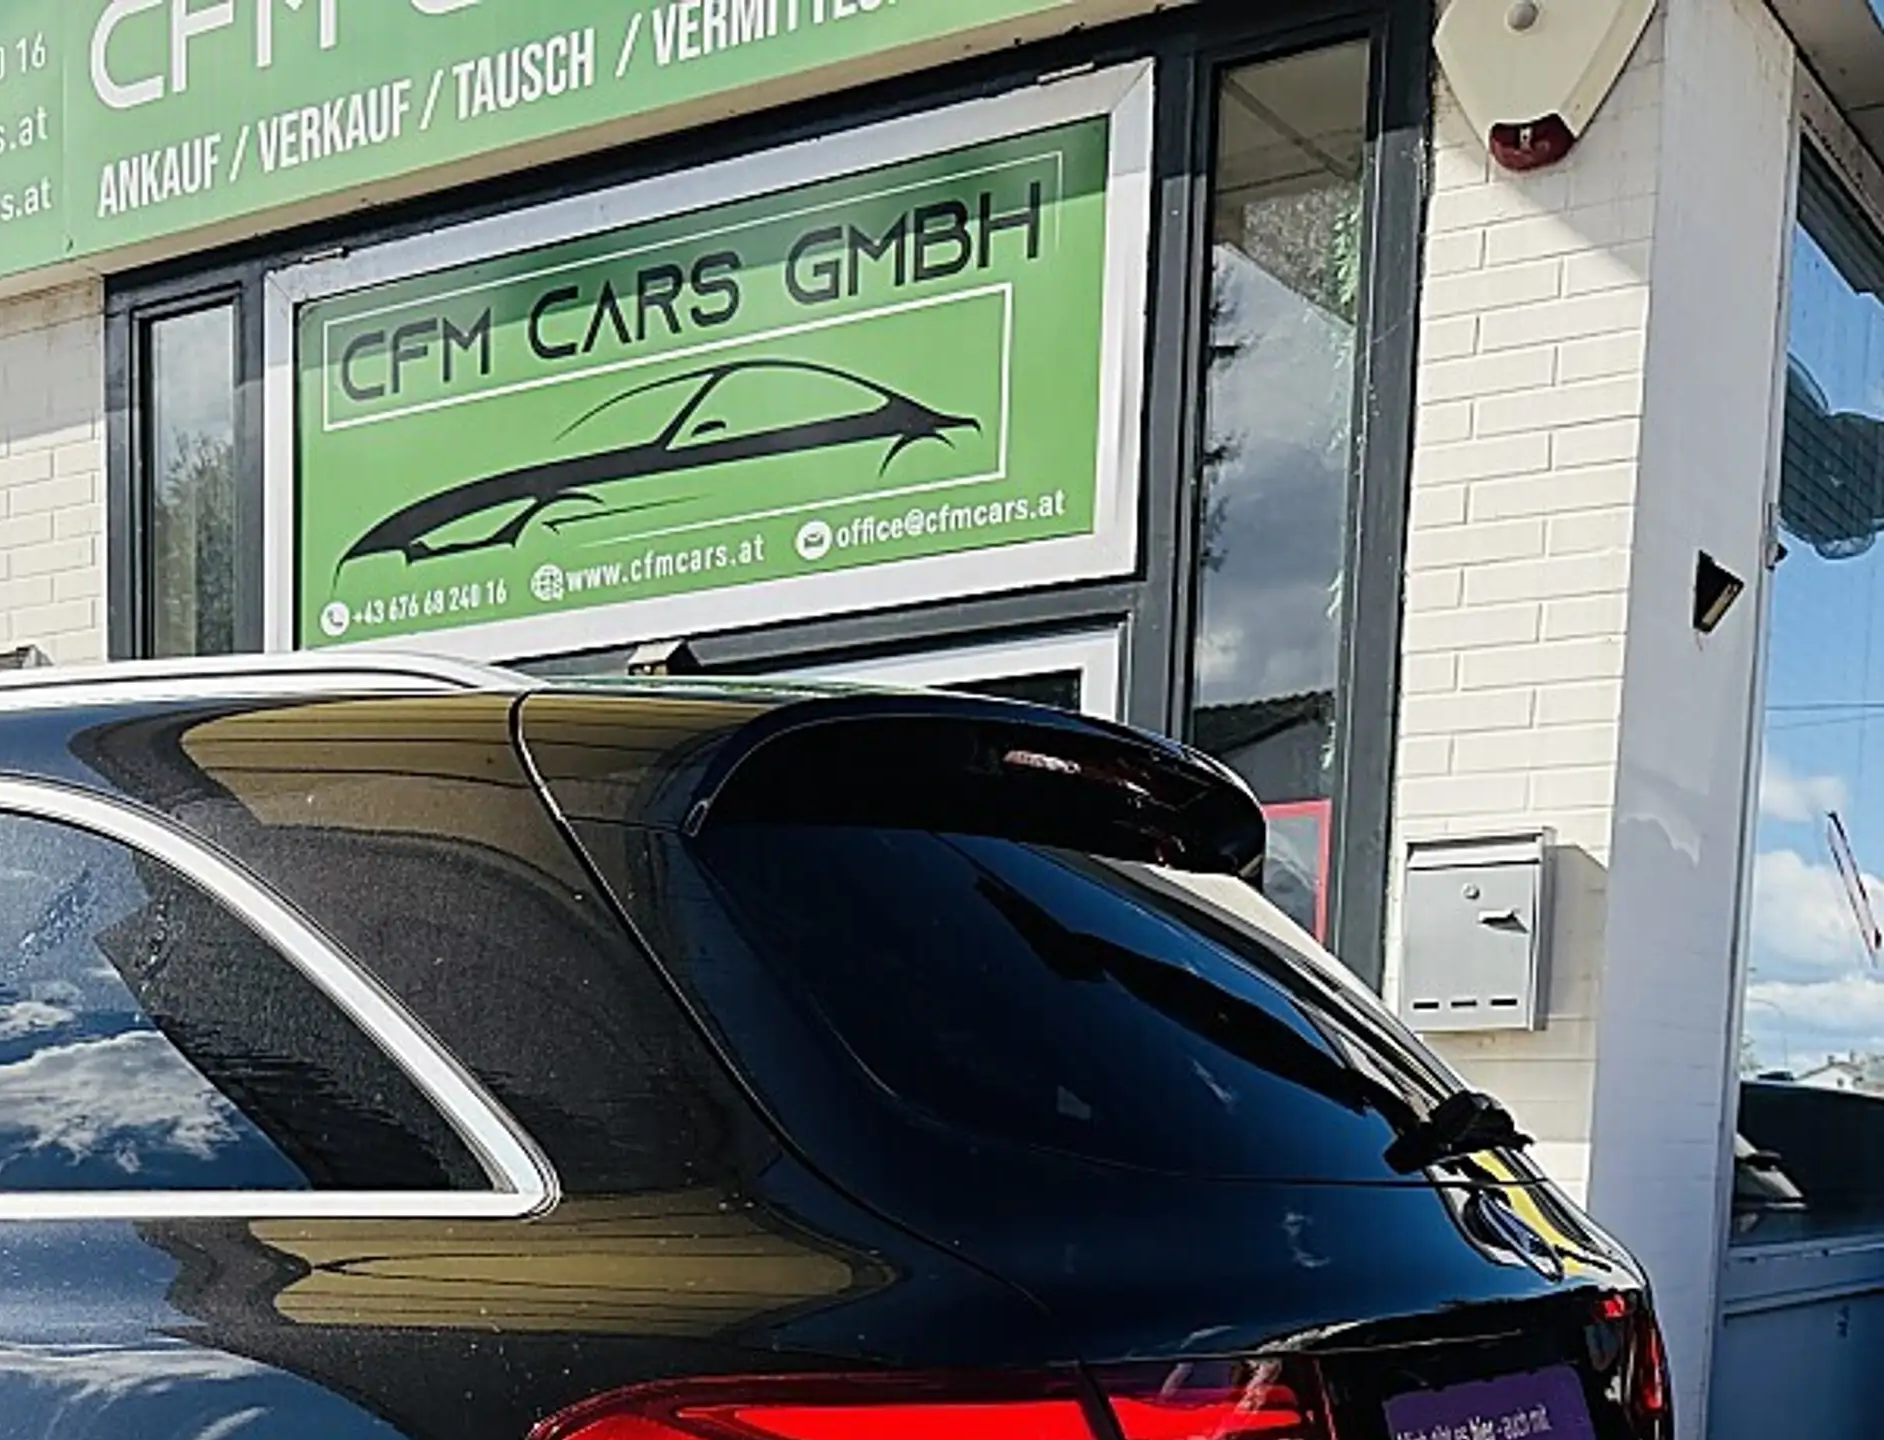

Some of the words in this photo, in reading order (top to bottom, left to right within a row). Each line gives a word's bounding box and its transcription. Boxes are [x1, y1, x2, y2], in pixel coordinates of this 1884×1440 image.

[15, 31, 47, 73] 16
[97, 131, 223, 219] ANKAUF
[257, 78, 413, 175] VERKAUF
[451, 26, 595, 121] TAUSCH
[340, 306, 495, 403] CFM
[527, 251, 743, 362] CARS
[784, 180, 1042, 306] GMBH
[836, 488, 1066, 549] office@cfmcars.at
[564, 533, 765, 593] www.cfmcars.at
[351, 599, 385, 626] +43
[388, 592, 419, 622] 676
[423, 588, 445, 617] 68
[448, 583, 482, 612] 240
[486, 577, 508, 606] 16
